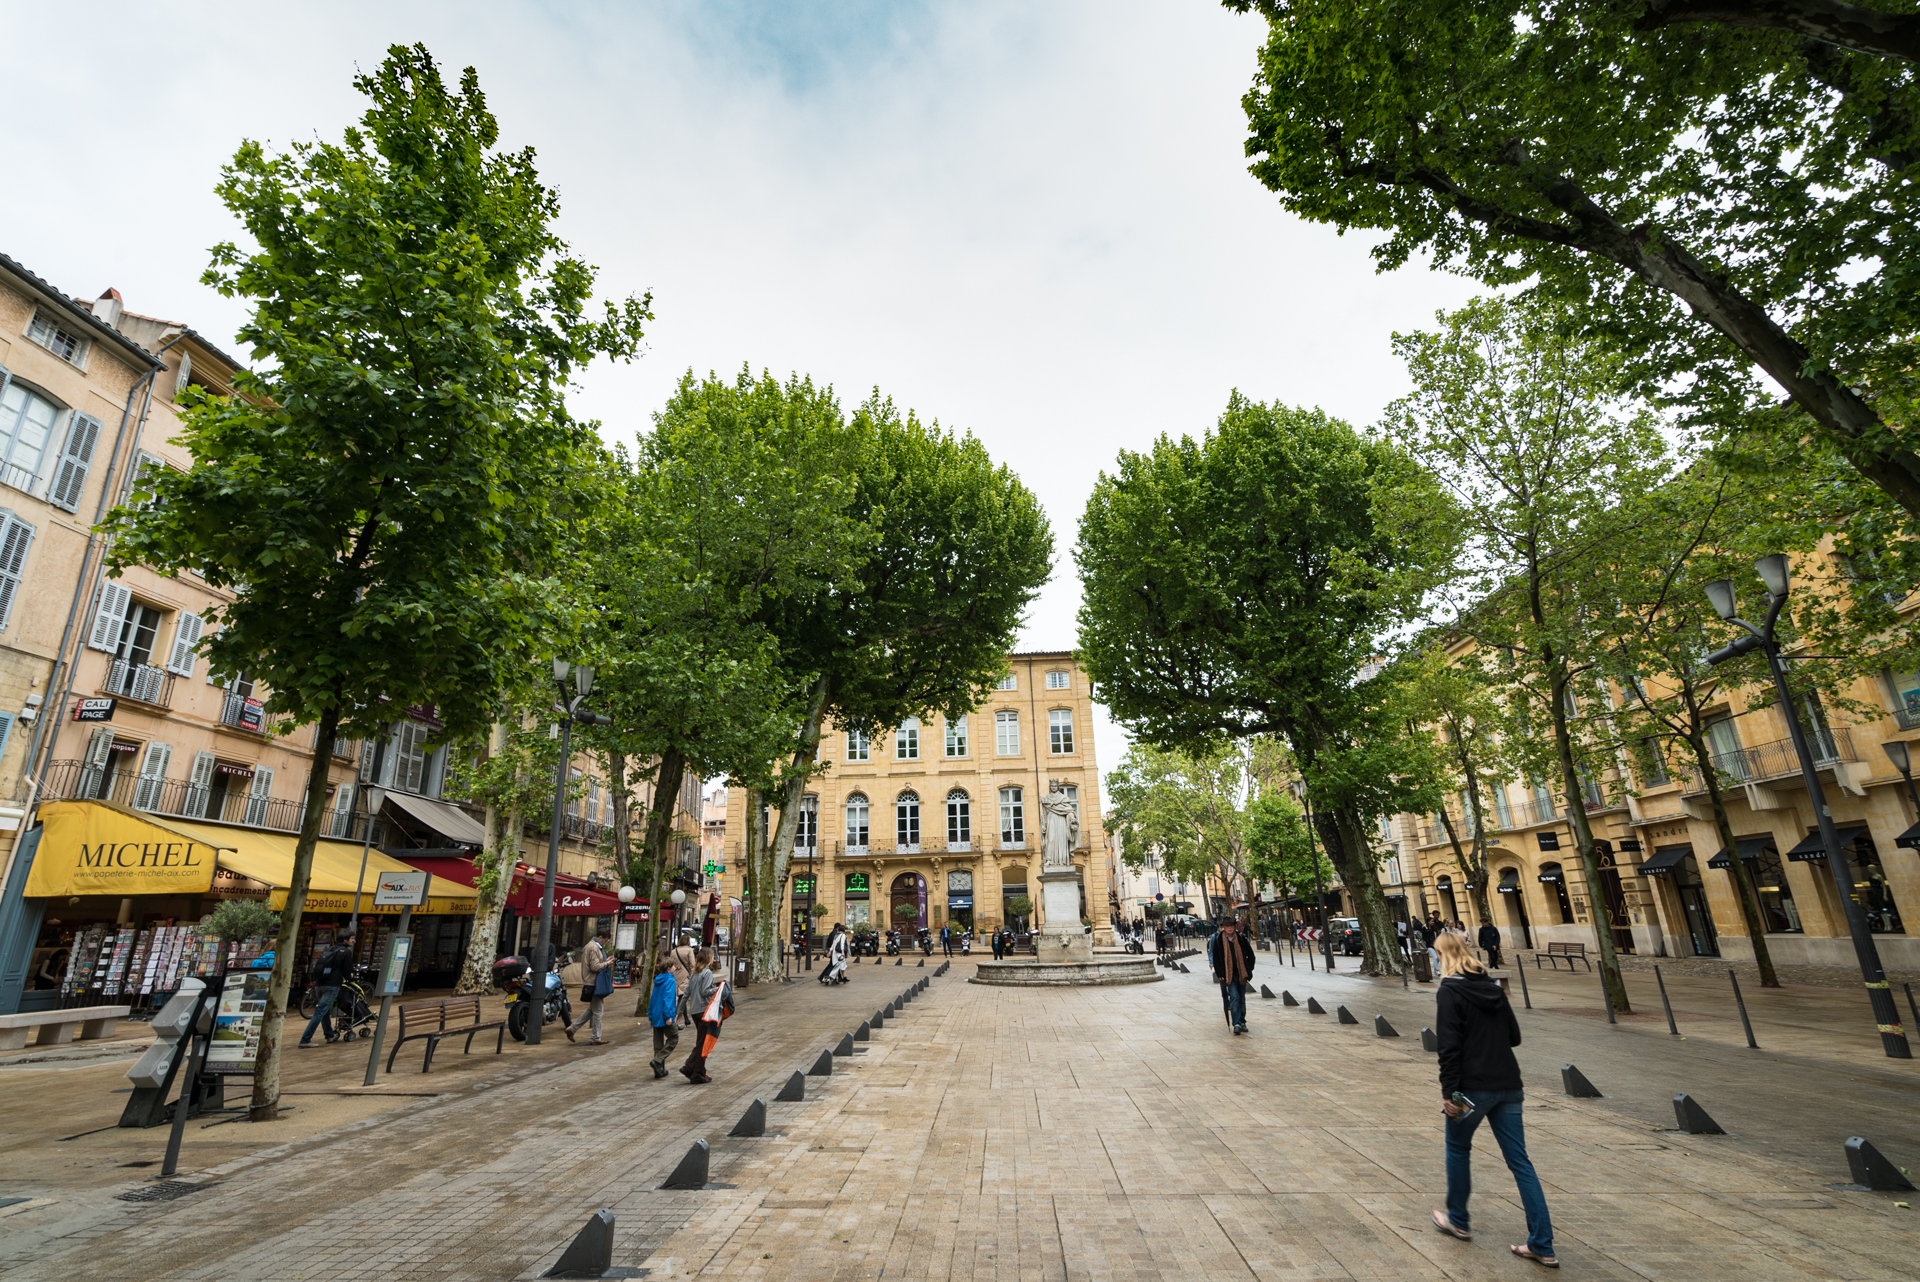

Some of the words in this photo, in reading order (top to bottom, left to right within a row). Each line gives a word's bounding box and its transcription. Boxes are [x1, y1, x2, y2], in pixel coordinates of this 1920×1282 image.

[222, 767, 252, 777] MICHEL
[76, 843, 202, 868] MICHEL
[73, 869, 199, 879] www.papeterie-michel-aix.com
[214, 870, 248, 881] eaux
[391, 884, 404, 892] AIX
[303, 898, 348, 909] apeterie
[562, 895, 590, 907] René
